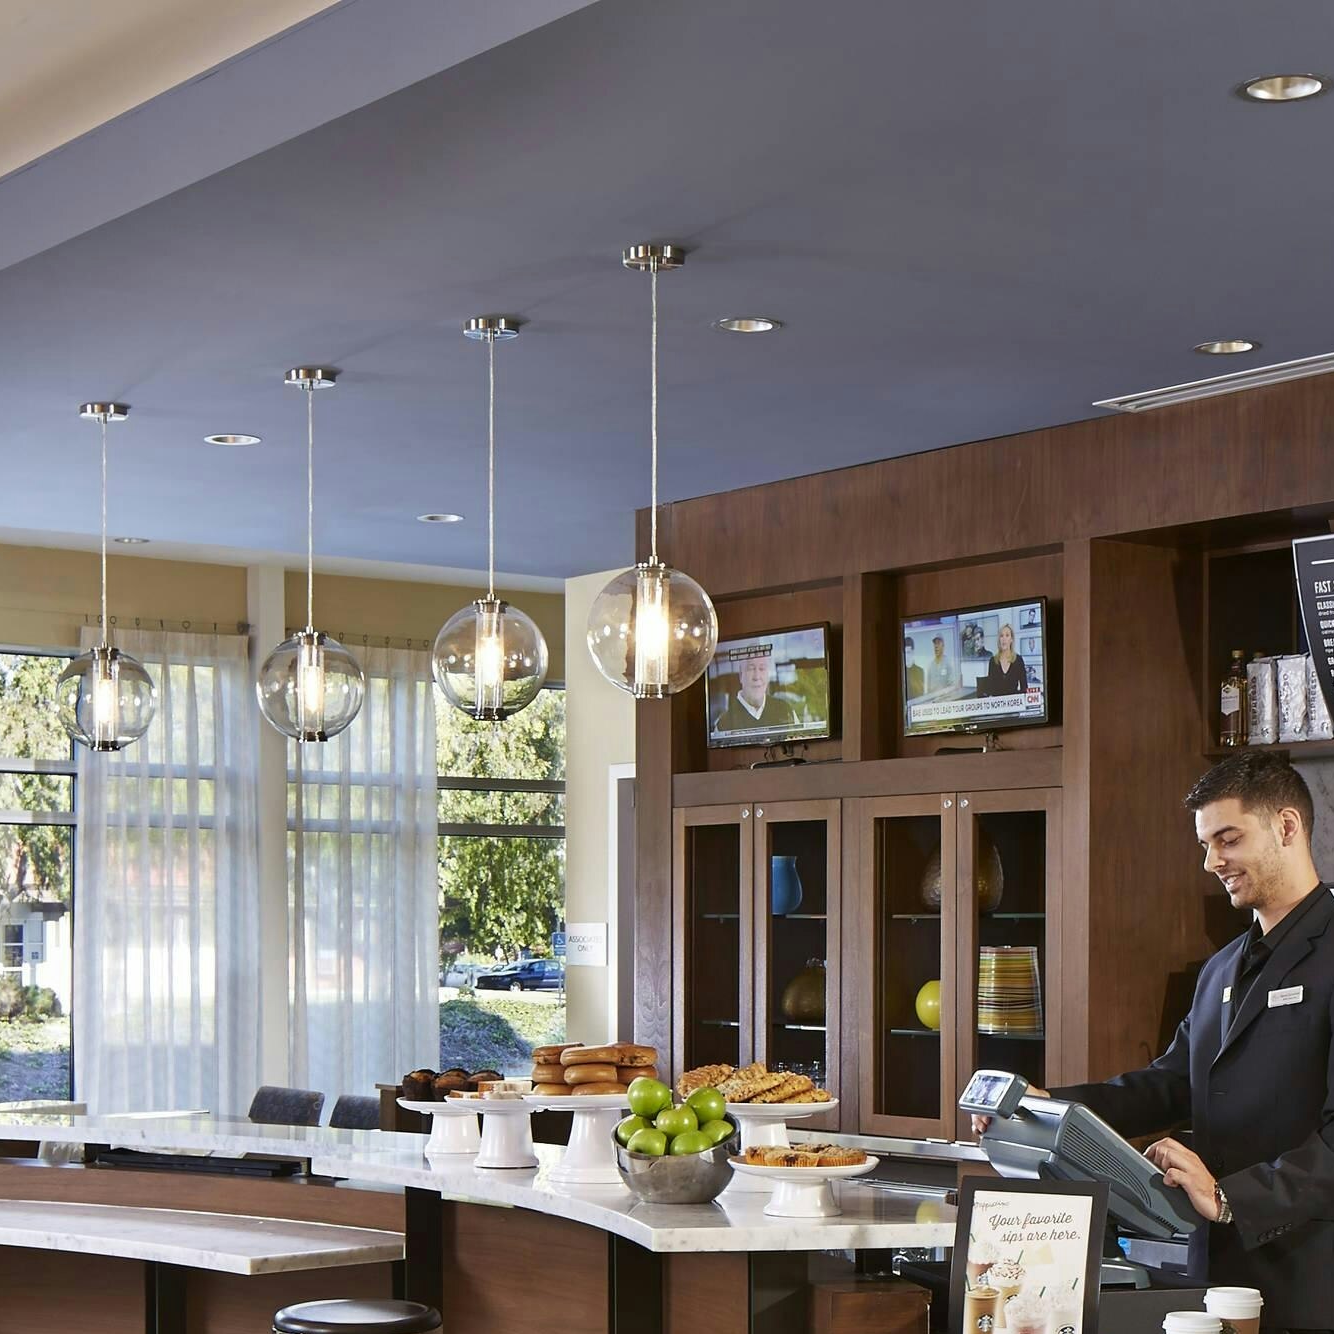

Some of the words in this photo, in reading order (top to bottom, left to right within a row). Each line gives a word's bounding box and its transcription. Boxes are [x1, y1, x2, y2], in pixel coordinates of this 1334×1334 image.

[1314, 581, 1331, 594] FAST
[965, 703, 983, 712] GROUPS
[983, 702, 990, 710] TO
[991, 700, 1007, 709] NORTH
[1007, 698, 1023, 707] KOREA
[989, 1213, 1022, 1231] Your
[1022, 1212, 1073, 1230] favorite
[1000, 1231, 1023, 1244] sips
[1027, 1231, 1048, 1241] are
[1049, 1228, 1081, 1241] here.
